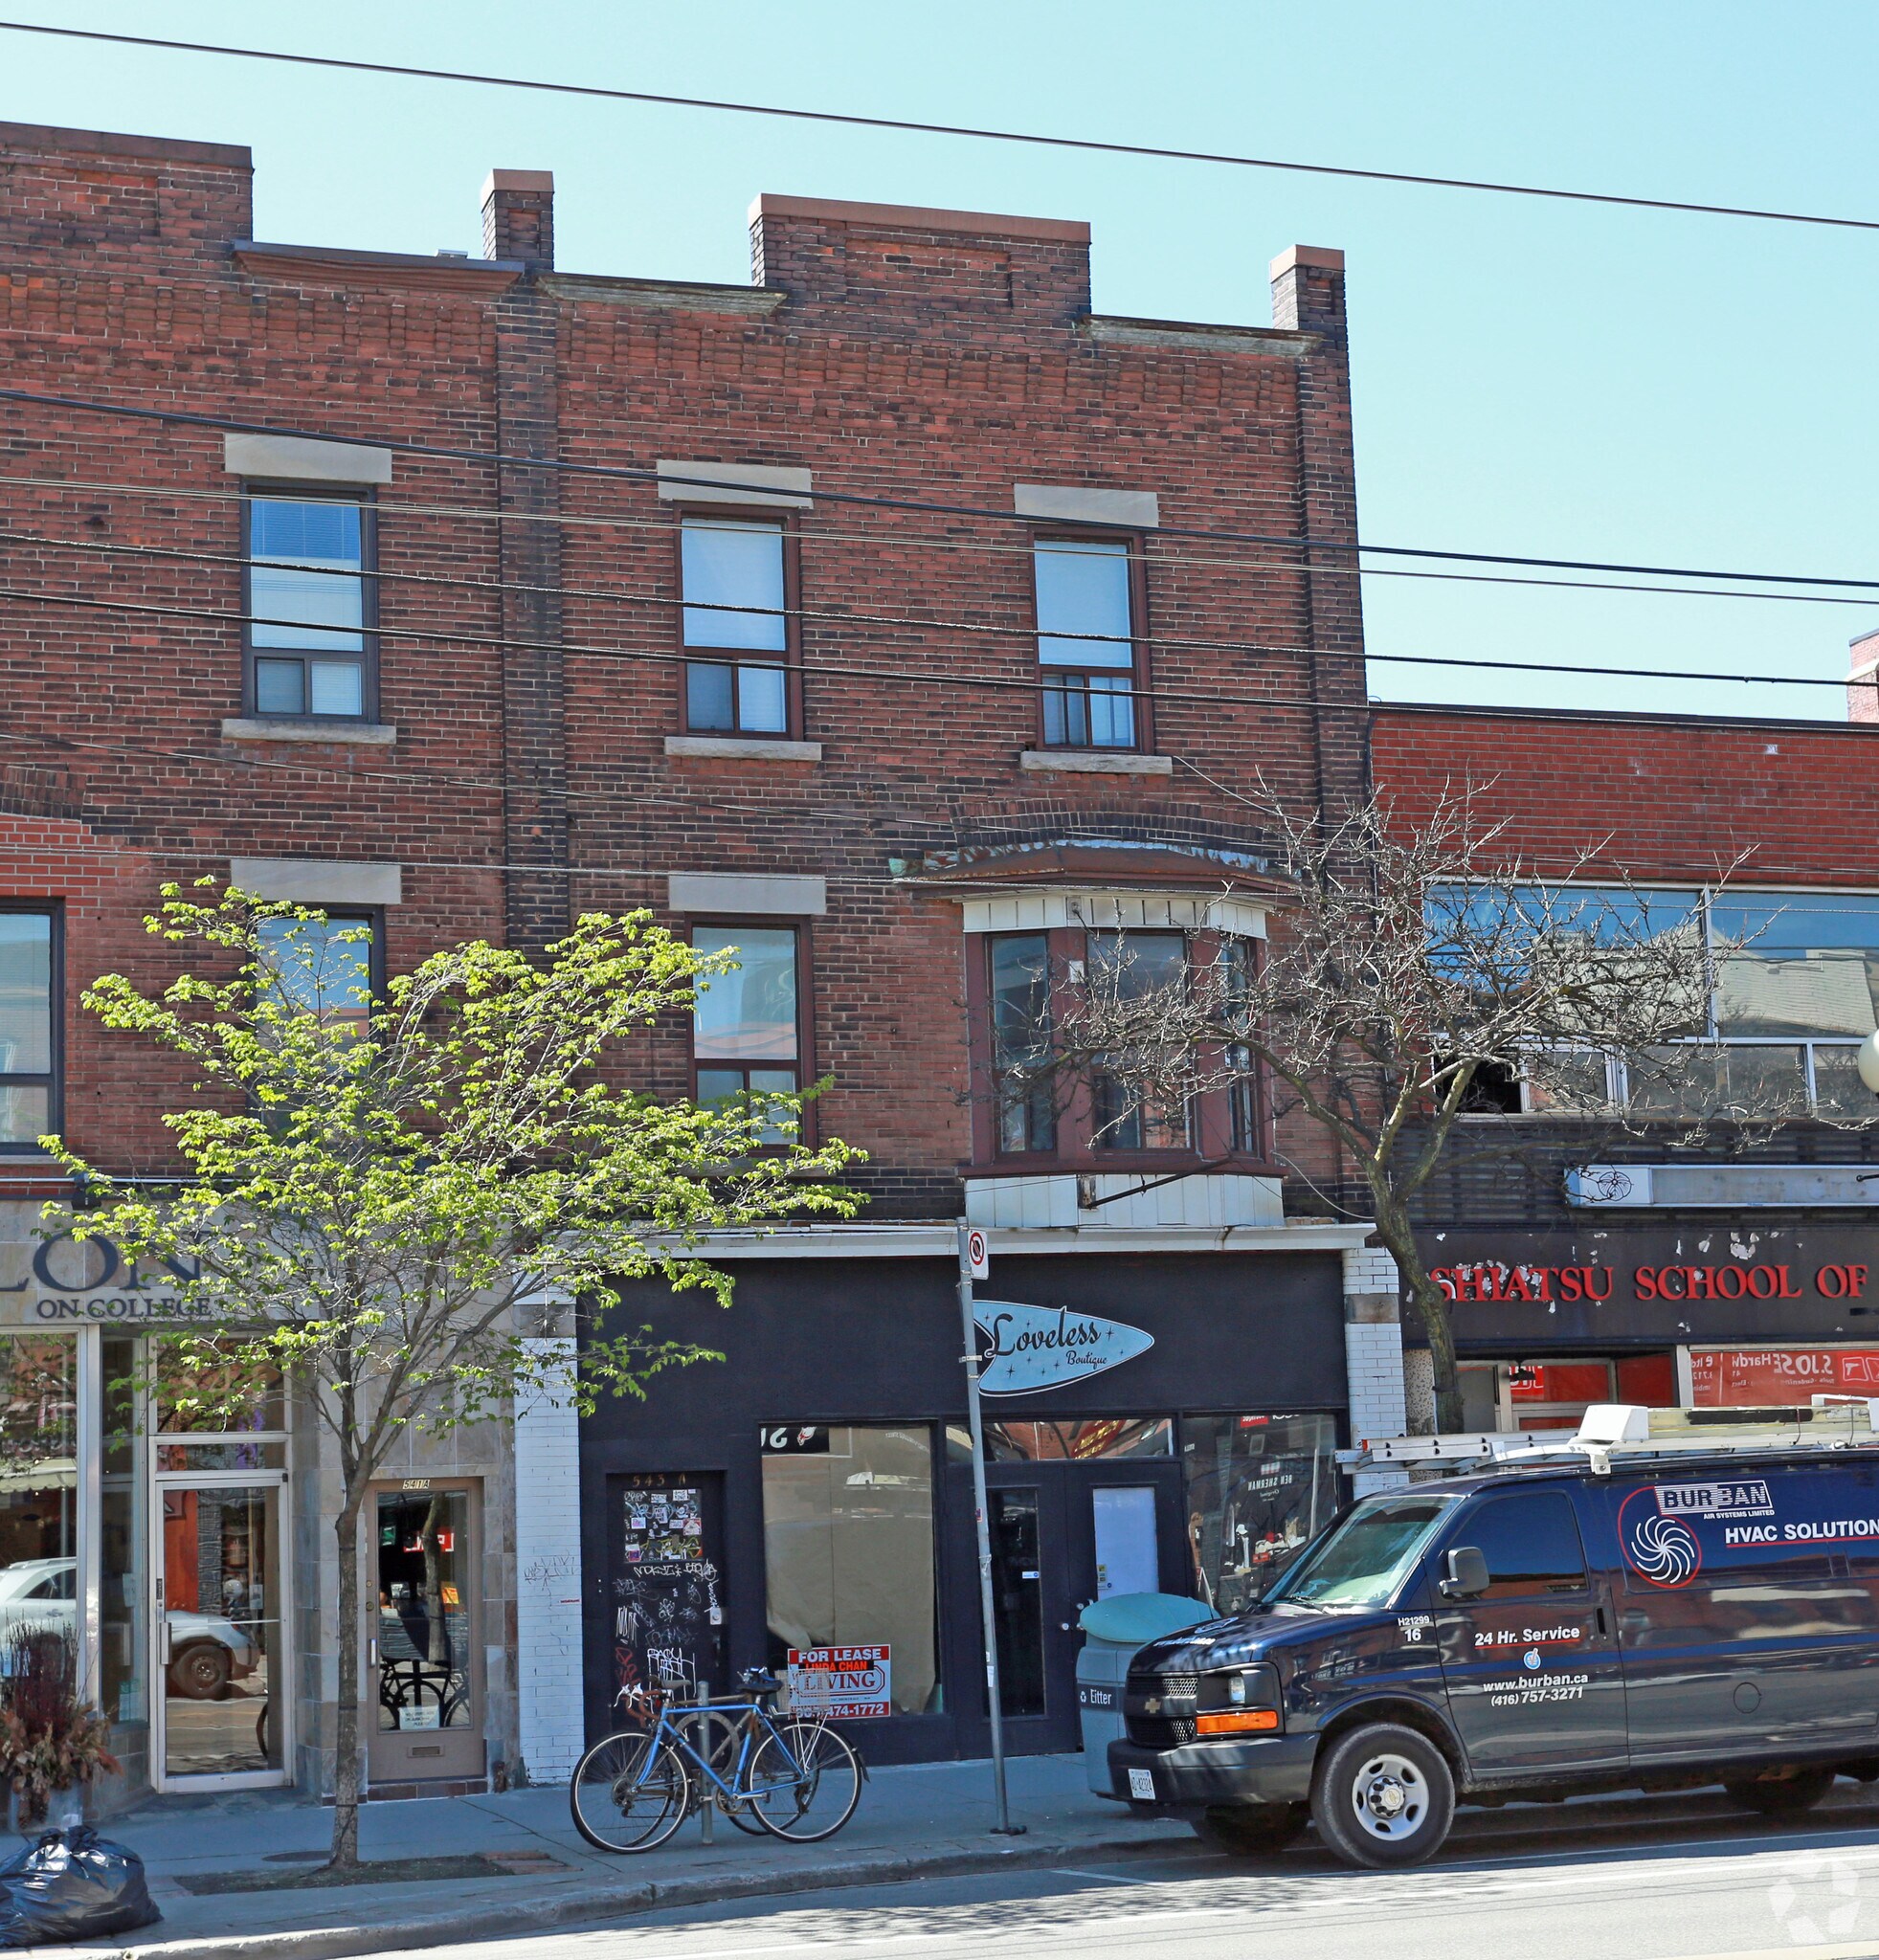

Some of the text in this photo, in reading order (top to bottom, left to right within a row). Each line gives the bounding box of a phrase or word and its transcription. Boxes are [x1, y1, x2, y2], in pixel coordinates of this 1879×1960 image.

[0, 1231, 212, 1292] ON
[1430, 1264, 1868, 1303] SHIATSU SCHOOL OF
[36, 1298, 212, 1319] ON COLLEGE
[986, 1307, 1103, 1356] Loveless
[1065, 1349, 1107, 1370] Boutique
[403, 1480, 430, 1489] 541A
[1663, 1486, 1767, 1508] BURBAN
[1725, 1525, 1778, 1544] HVAC
[1398, 1615, 1430, 1626] H21299
[1404, 1629, 1422, 1642] 16
[1474, 1626, 1580, 1646] 24 Hr. Service
[798, 1648, 882, 1663] FOR LEASE
[839, 1660, 867, 1672] CHAN
[804, 1672, 876, 1691] LIVING
[1483, 1674, 1589, 1692] www.burban.ca
[1490, 1686, 1584, 1707] (416) 757-3271
